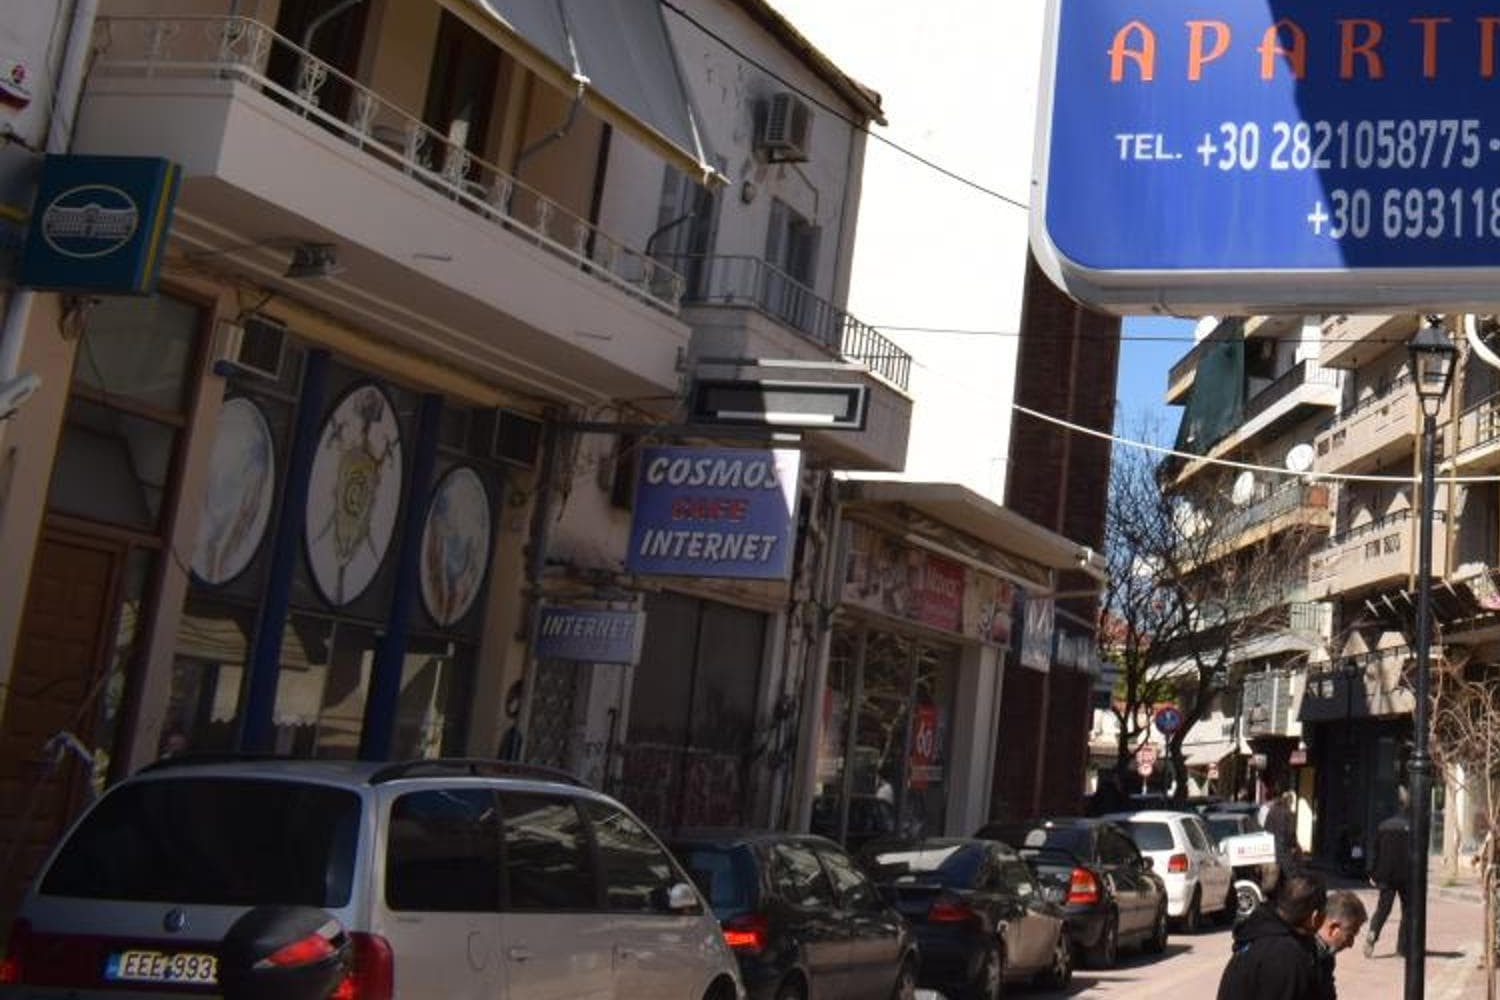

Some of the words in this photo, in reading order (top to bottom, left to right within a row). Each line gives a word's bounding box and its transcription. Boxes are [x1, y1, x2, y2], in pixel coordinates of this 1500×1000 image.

[1116, 132, 1183, 160] TEL.
[1196, 121, 1260, 169] +30
[1270, 119, 1480, 169] 2821058775
[1306, 190, 1370, 238] +30
[640, 529, 778, 561] INTERNET
[543, 615, 634, 639] INTERNET
